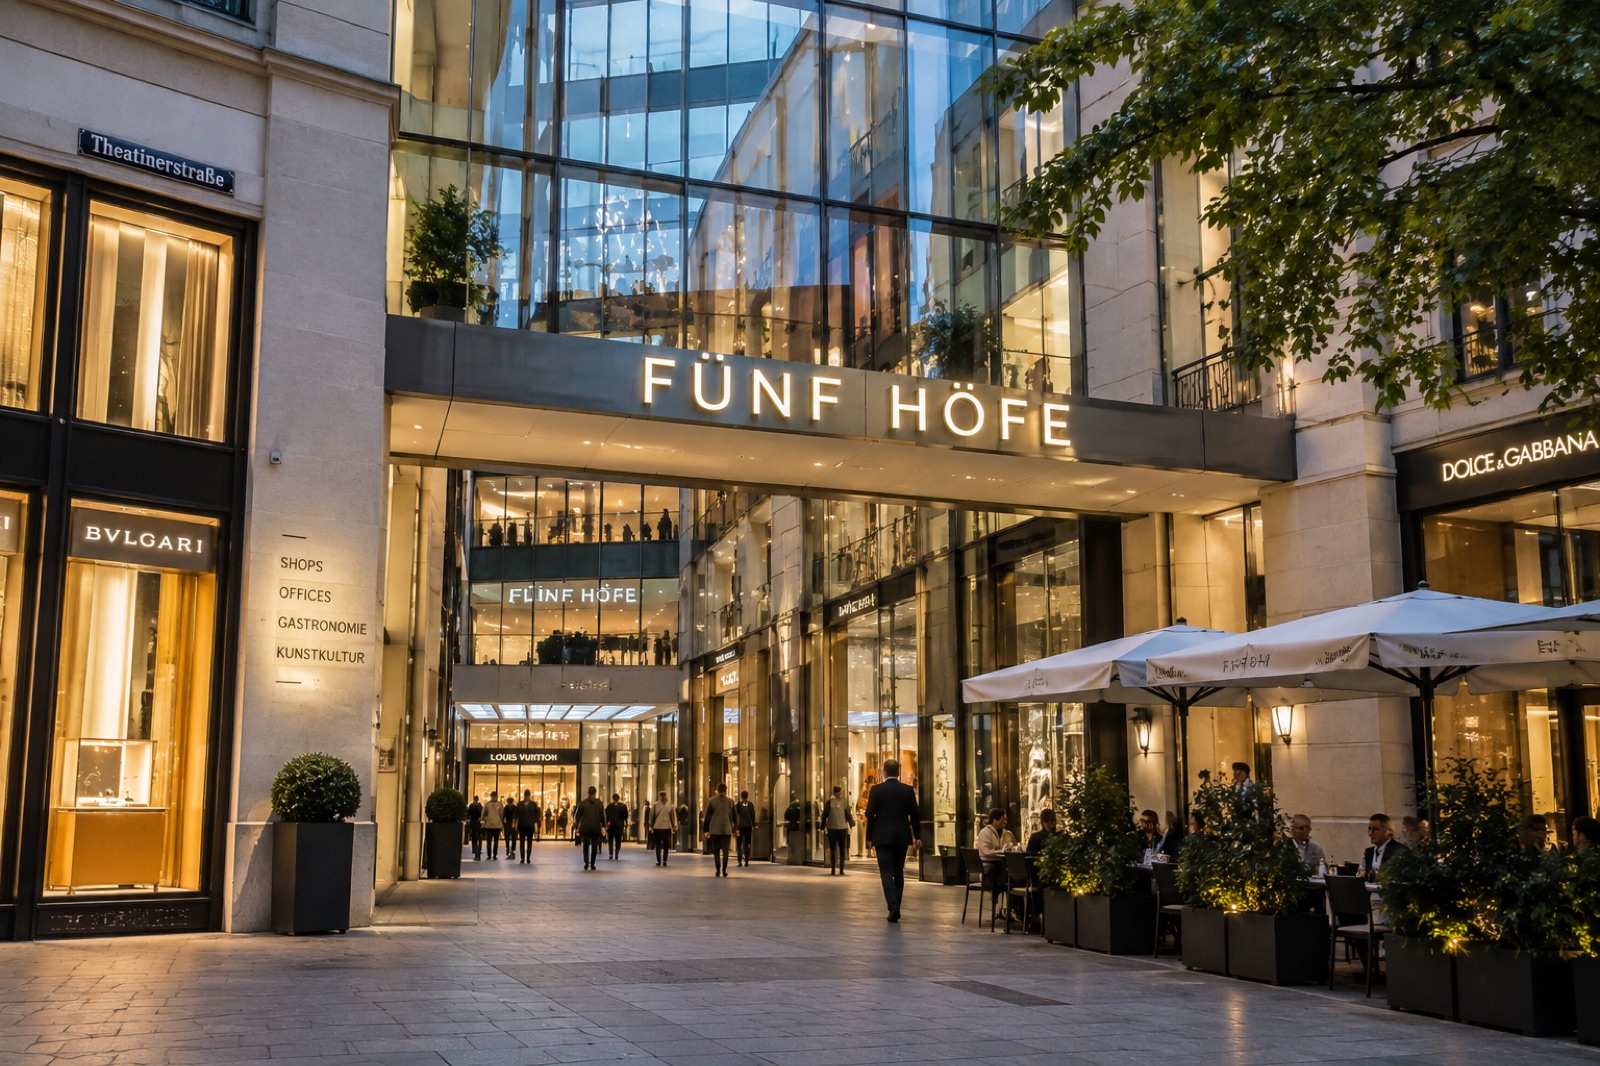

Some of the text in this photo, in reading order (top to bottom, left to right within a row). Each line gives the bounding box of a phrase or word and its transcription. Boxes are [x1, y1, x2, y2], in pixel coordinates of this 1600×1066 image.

[91, 133, 225, 187] Theatinerstraße
[643, 352, 1072, 447] FÜNF HÖFE
[85, 525, 204, 554] BVLGARI
[280, 556, 324, 573] SHOPS
[279, 586, 332, 603] OFFICES
[581, 583, 638, 603] HÖFE
[277, 616, 368, 636] GASTRONOMIE
[276, 646, 366, 664] KUNSTKULTUR
